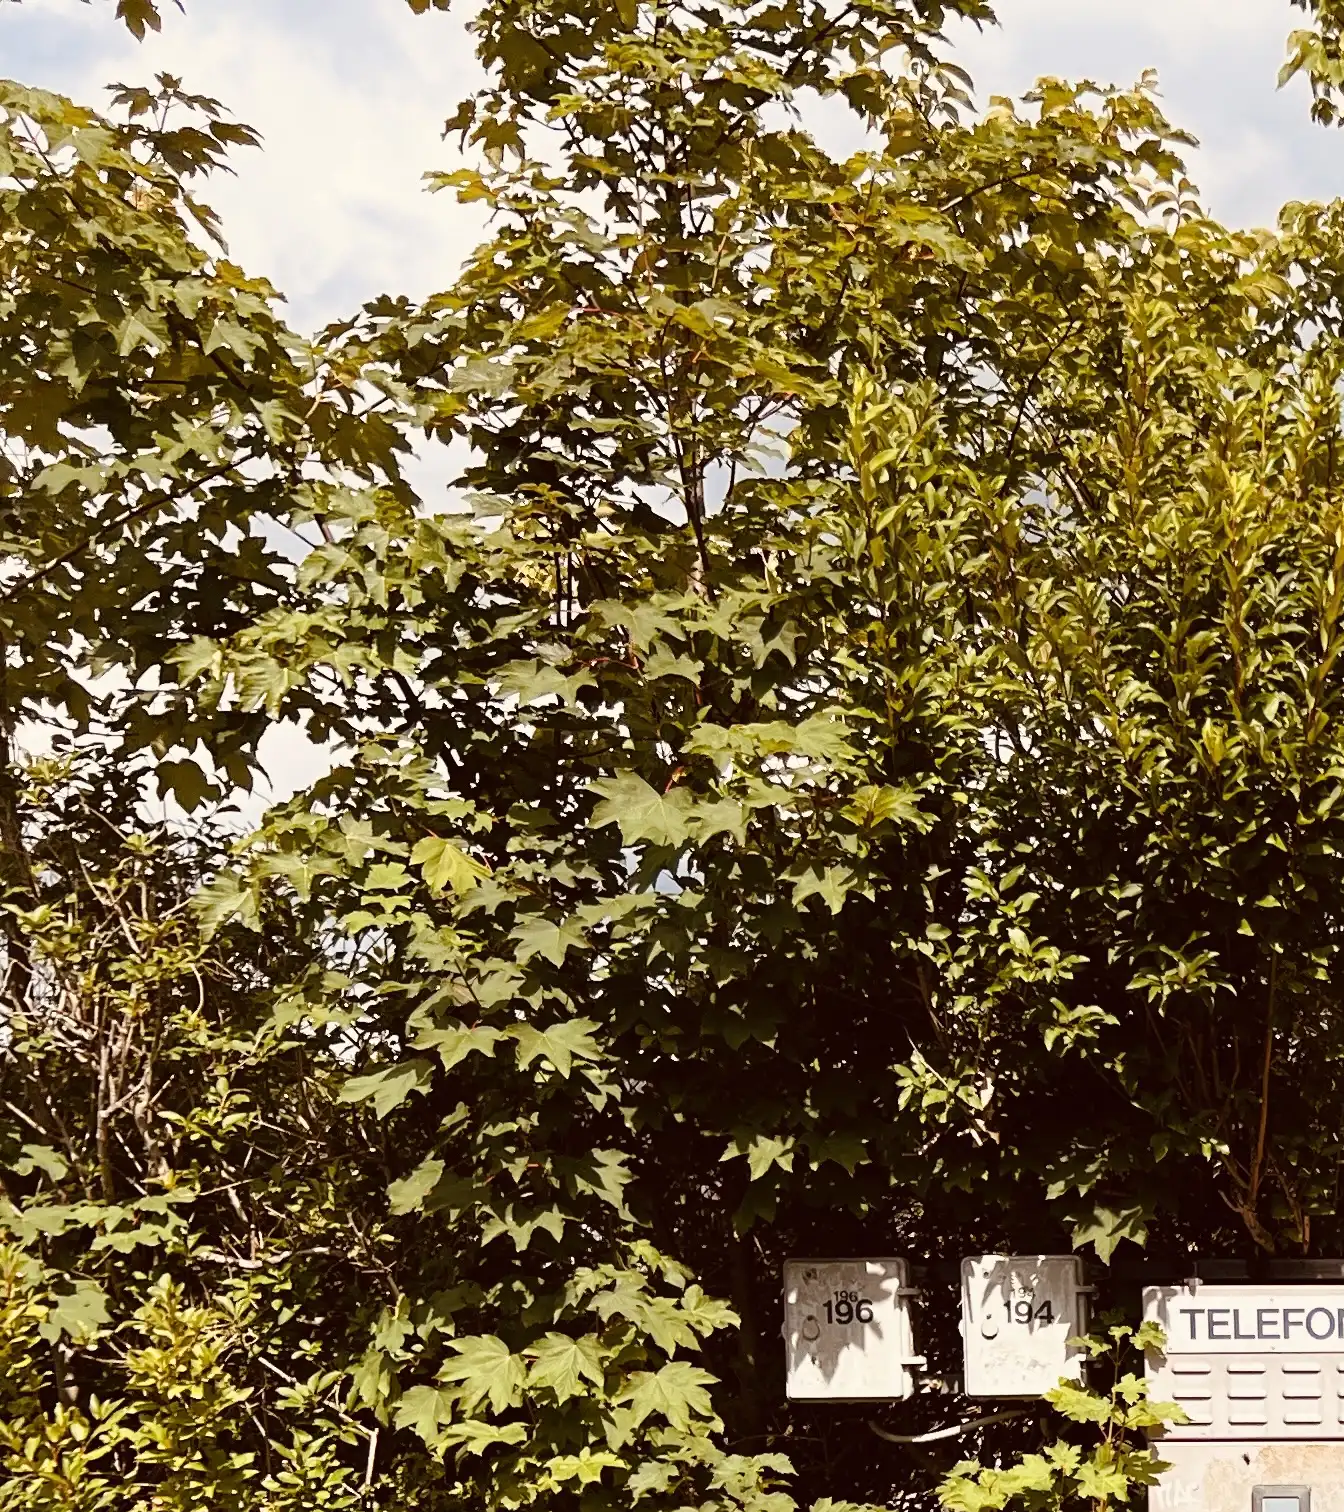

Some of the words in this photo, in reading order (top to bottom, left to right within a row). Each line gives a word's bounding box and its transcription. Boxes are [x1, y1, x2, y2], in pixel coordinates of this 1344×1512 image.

[833, 1290, 858, 1303] 196
[822, 1299, 874, 1325] 196
[1003, 1300, 1055, 1324] 194
